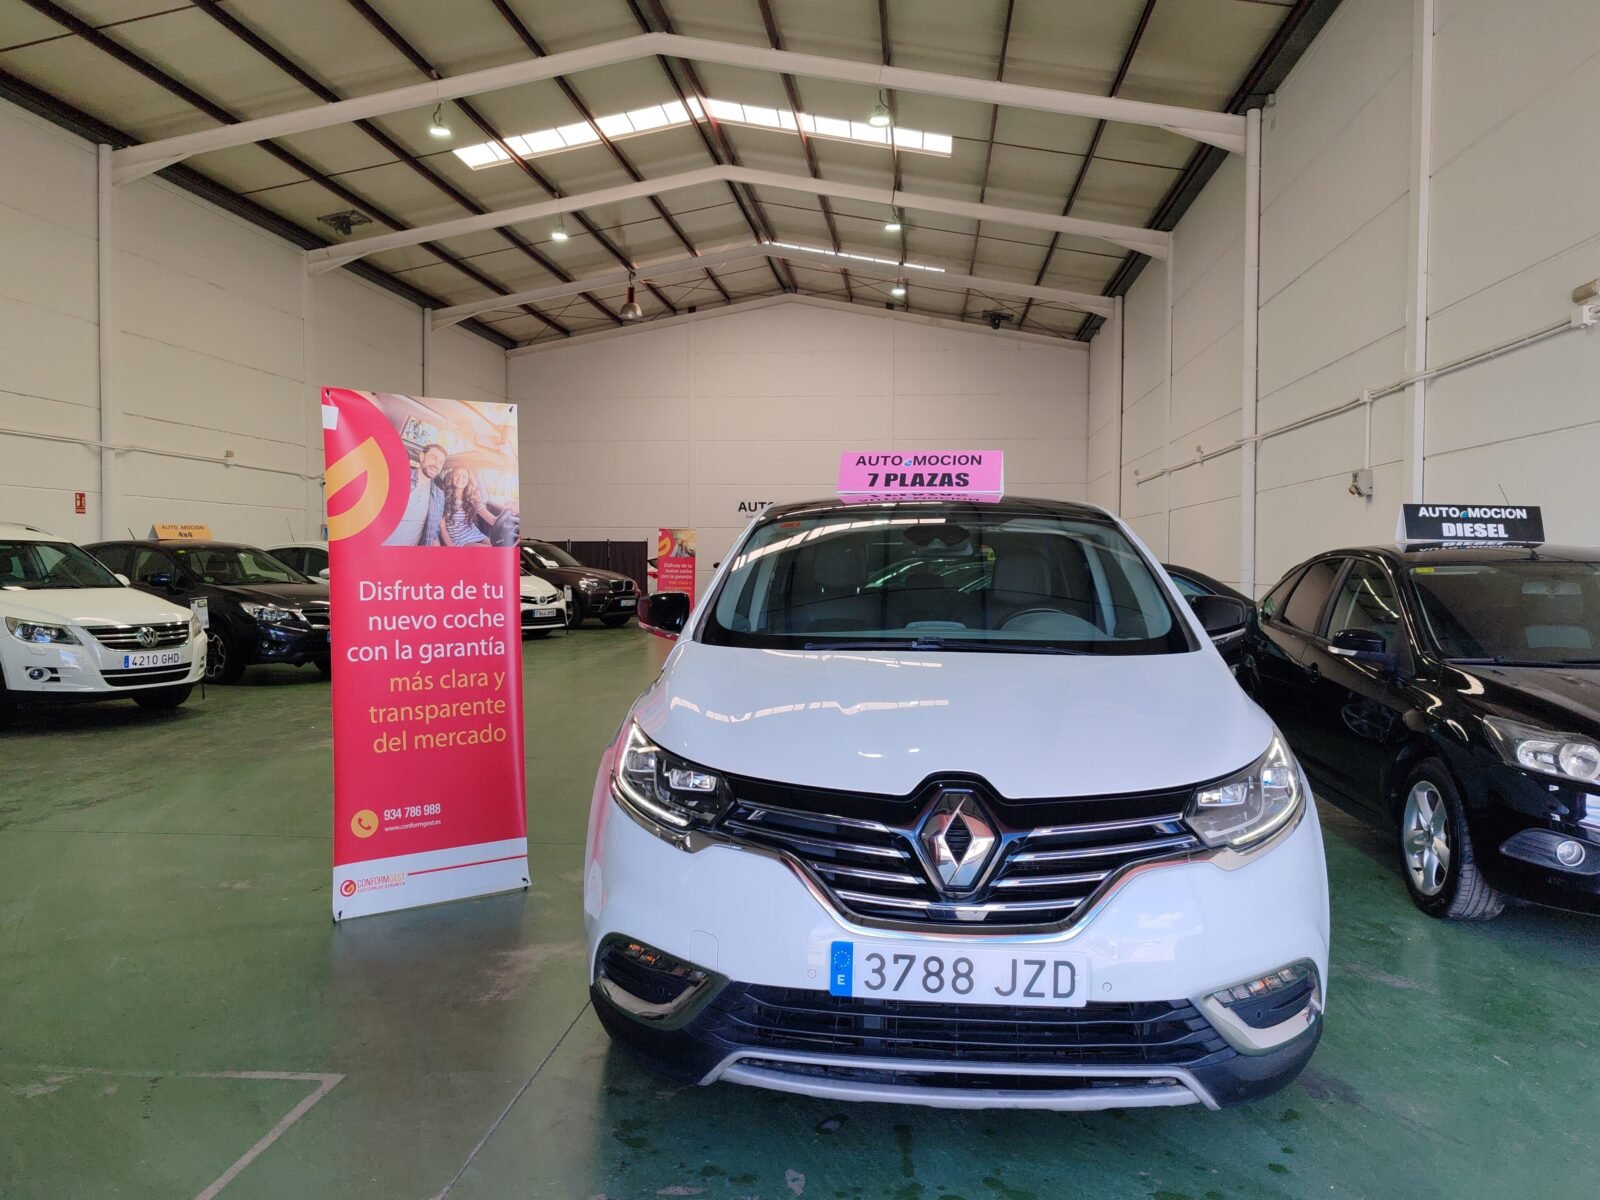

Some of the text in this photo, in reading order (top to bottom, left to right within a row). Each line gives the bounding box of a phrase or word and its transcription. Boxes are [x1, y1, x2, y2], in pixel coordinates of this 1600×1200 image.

[867, 472, 970, 487] 7 PLAZAS
[1441, 522, 1509, 538] DIESEL
[359, 579, 504, 601] Disfruta de tu
[368, 608, 505, 631] nuevo coche
[131, 654, 159, 667] 4210
[161, 652, 180, 665] GHD
[347, 636, 505, 664] con la garantía
[390, 668, 506, 692] más clara y
[368, 697, 506, 724] transparente
[373, 723, 507, 753] del mercado
[384, 803, 441, 821] 934 786 988
[384, 819, 442, 832] www.conformgest.es
[836, 952, 1077, 999] E 3788 JZD
